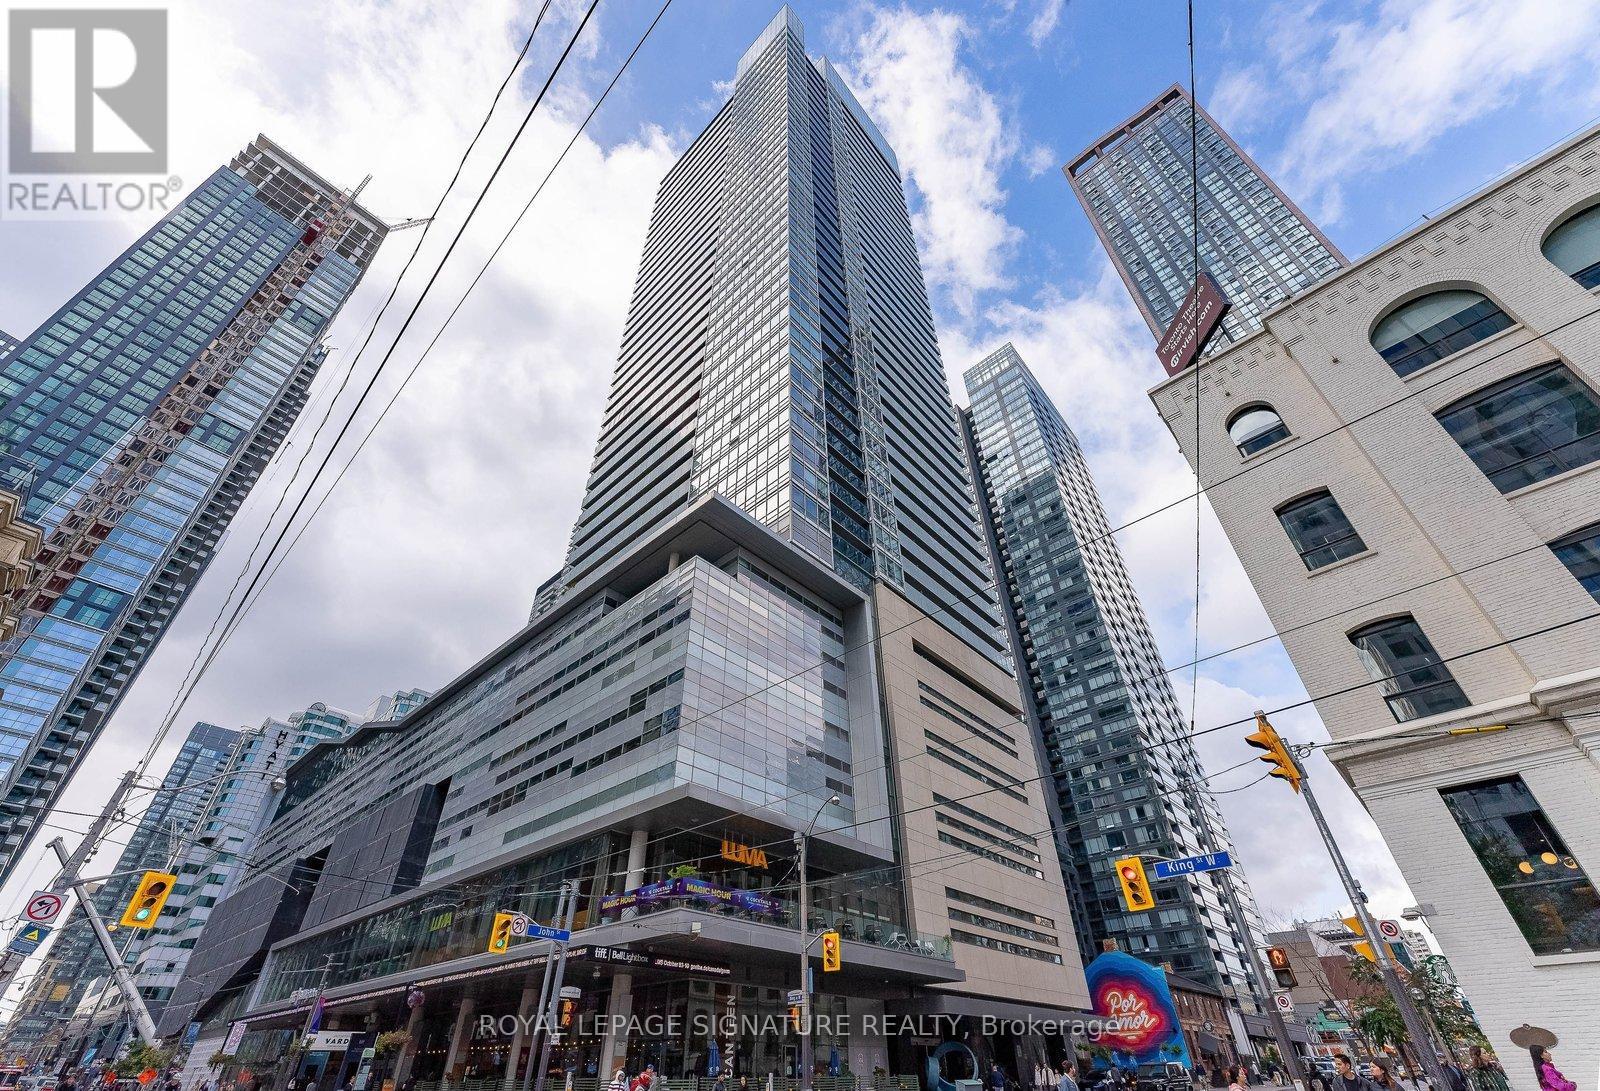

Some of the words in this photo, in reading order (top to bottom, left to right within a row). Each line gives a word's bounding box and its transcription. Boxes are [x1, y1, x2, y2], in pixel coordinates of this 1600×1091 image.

[1161, 322, 1183, 354] Toronto
[1170, 325, 1188, 351] Starts
[721, 839, 769, 870] LUMA
[1167, 861, 1194, 872] King
[1205, 855, 1216, 866] W
[602, 898, 619, 909] MAGIC
[619, 894, 637, 905] HOUR
[686, 883, 710, 895] MAGIC
[711, 889, 731, 901] HOUR
[538, 926, 554, 938] John
[1106, 991, 1144, 1013] Por
